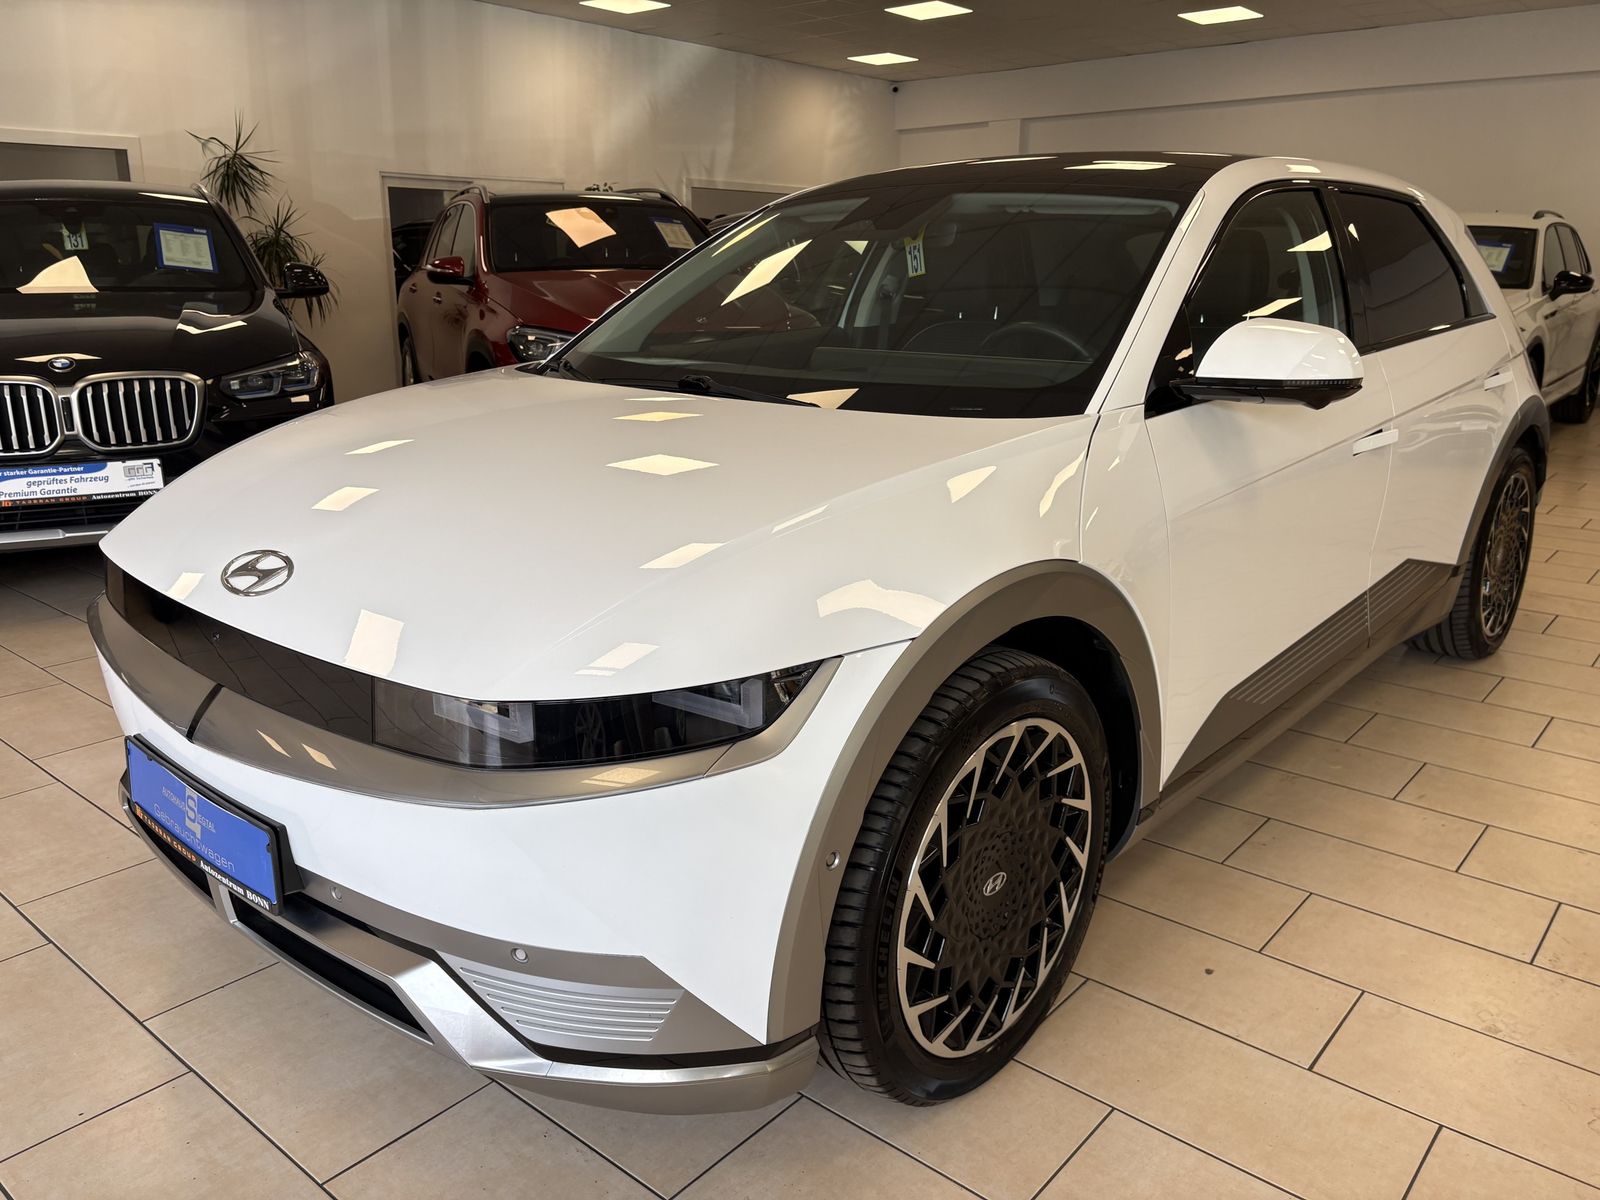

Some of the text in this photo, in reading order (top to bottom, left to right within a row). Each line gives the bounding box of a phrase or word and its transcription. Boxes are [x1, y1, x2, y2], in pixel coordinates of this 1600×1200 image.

[67, 233, 84, 249] 131
[908, 243, 923, 274] 151
[28, 466, 84, 475] Garantie-Partner
[26, 475, 110, 489] geprüftes Fahrzeug
[0, 486, 78, 498] Premium Garantie
[91, 492, 137, 500] Autozentrum
[153, 803, 236, 873] Gebrauchtwagen
[199, 860, 245, 896] Autozentrum
[245, 889, 270, 911] BONN
[876, 876, 902, 1010] MICHELIN
